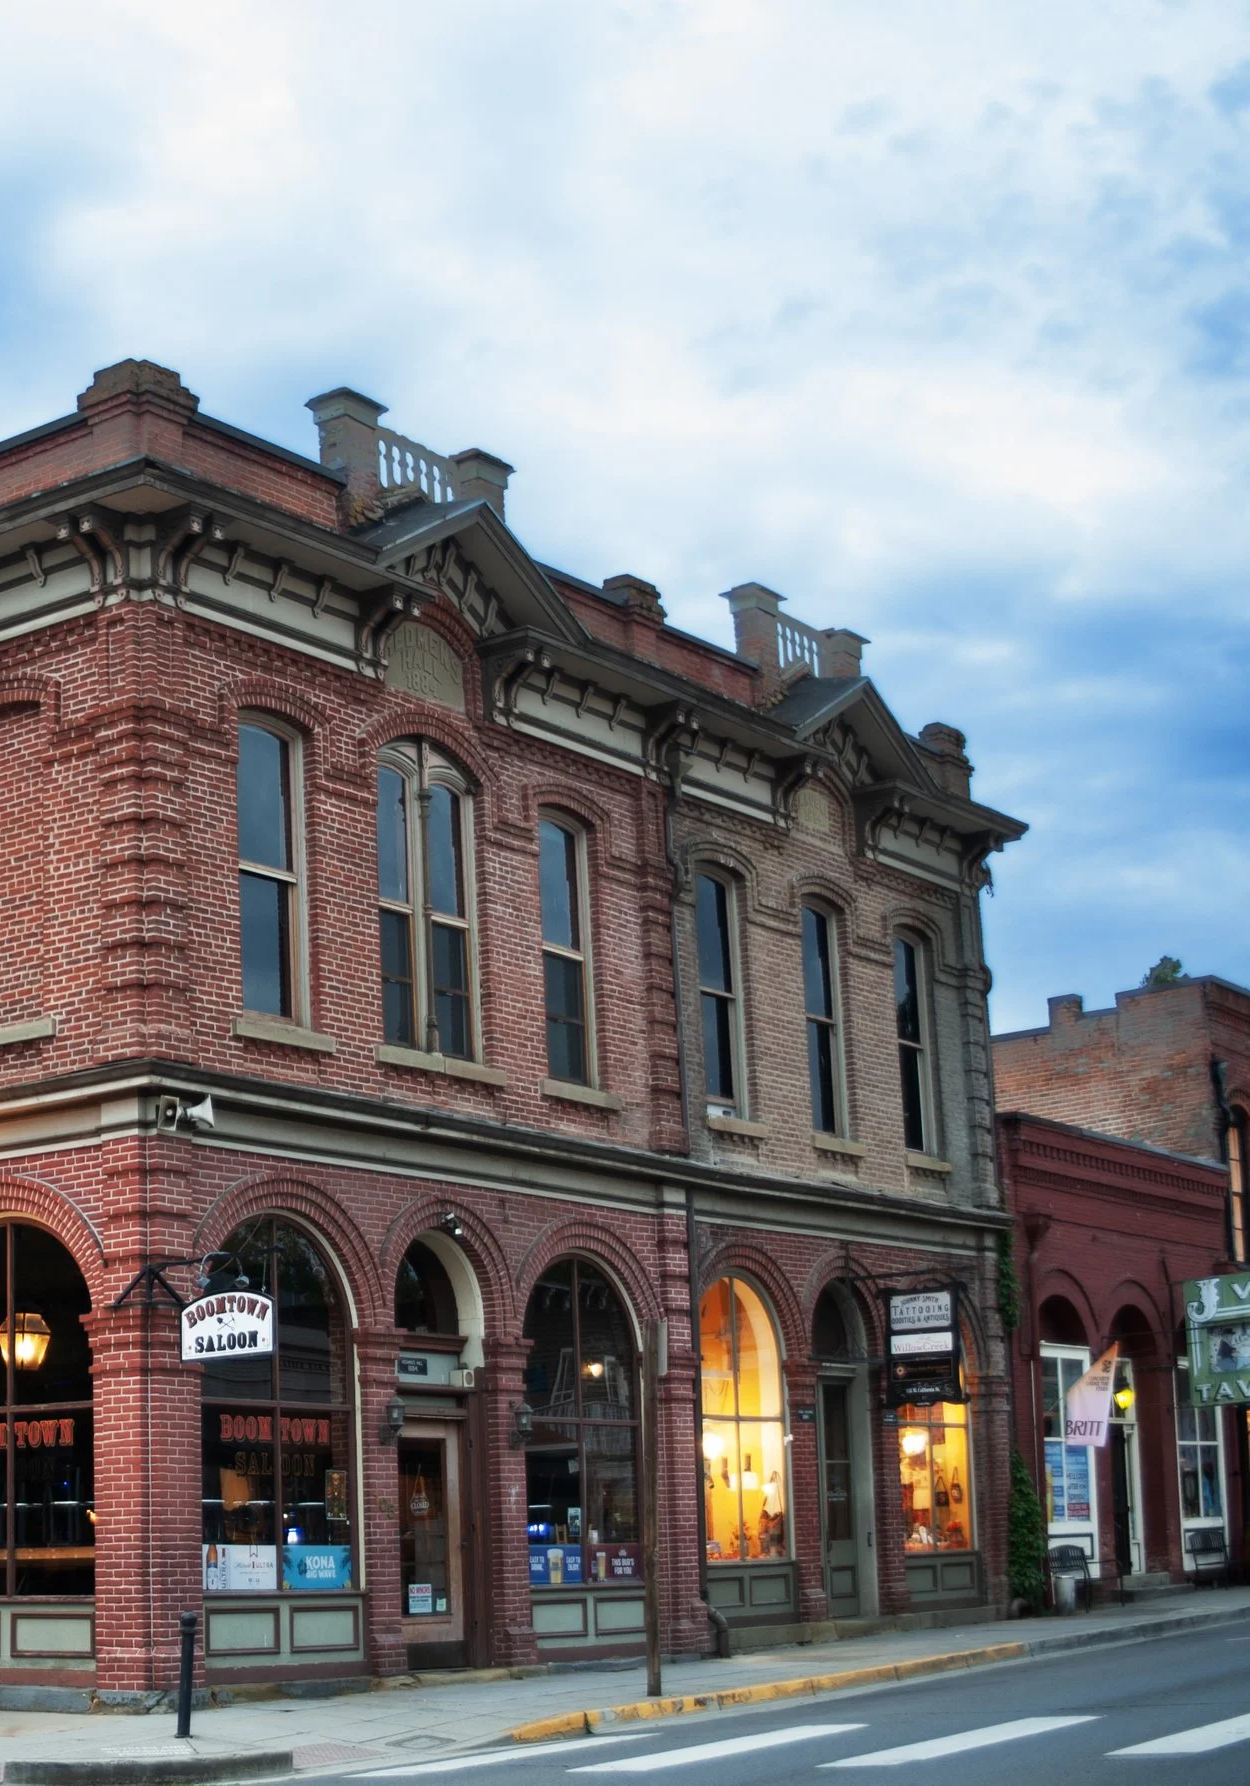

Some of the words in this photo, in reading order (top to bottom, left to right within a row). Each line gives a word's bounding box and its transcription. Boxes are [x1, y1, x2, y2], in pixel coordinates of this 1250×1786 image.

[184, 1295, 269, 1329] BOOMTOWN
[891, 1304, 949, 1316] TATTOOING
[195, 1330, 258, 1353] SALOON
[1065, 1420, 1103, 1437] BRITT
[235, 1451, 315, 1476] SALOON
[306, 1555, 335, 1569] KONA
[614, 1566, 623, 1574] FOR
[623, 1566, 632, 1574] YOU
